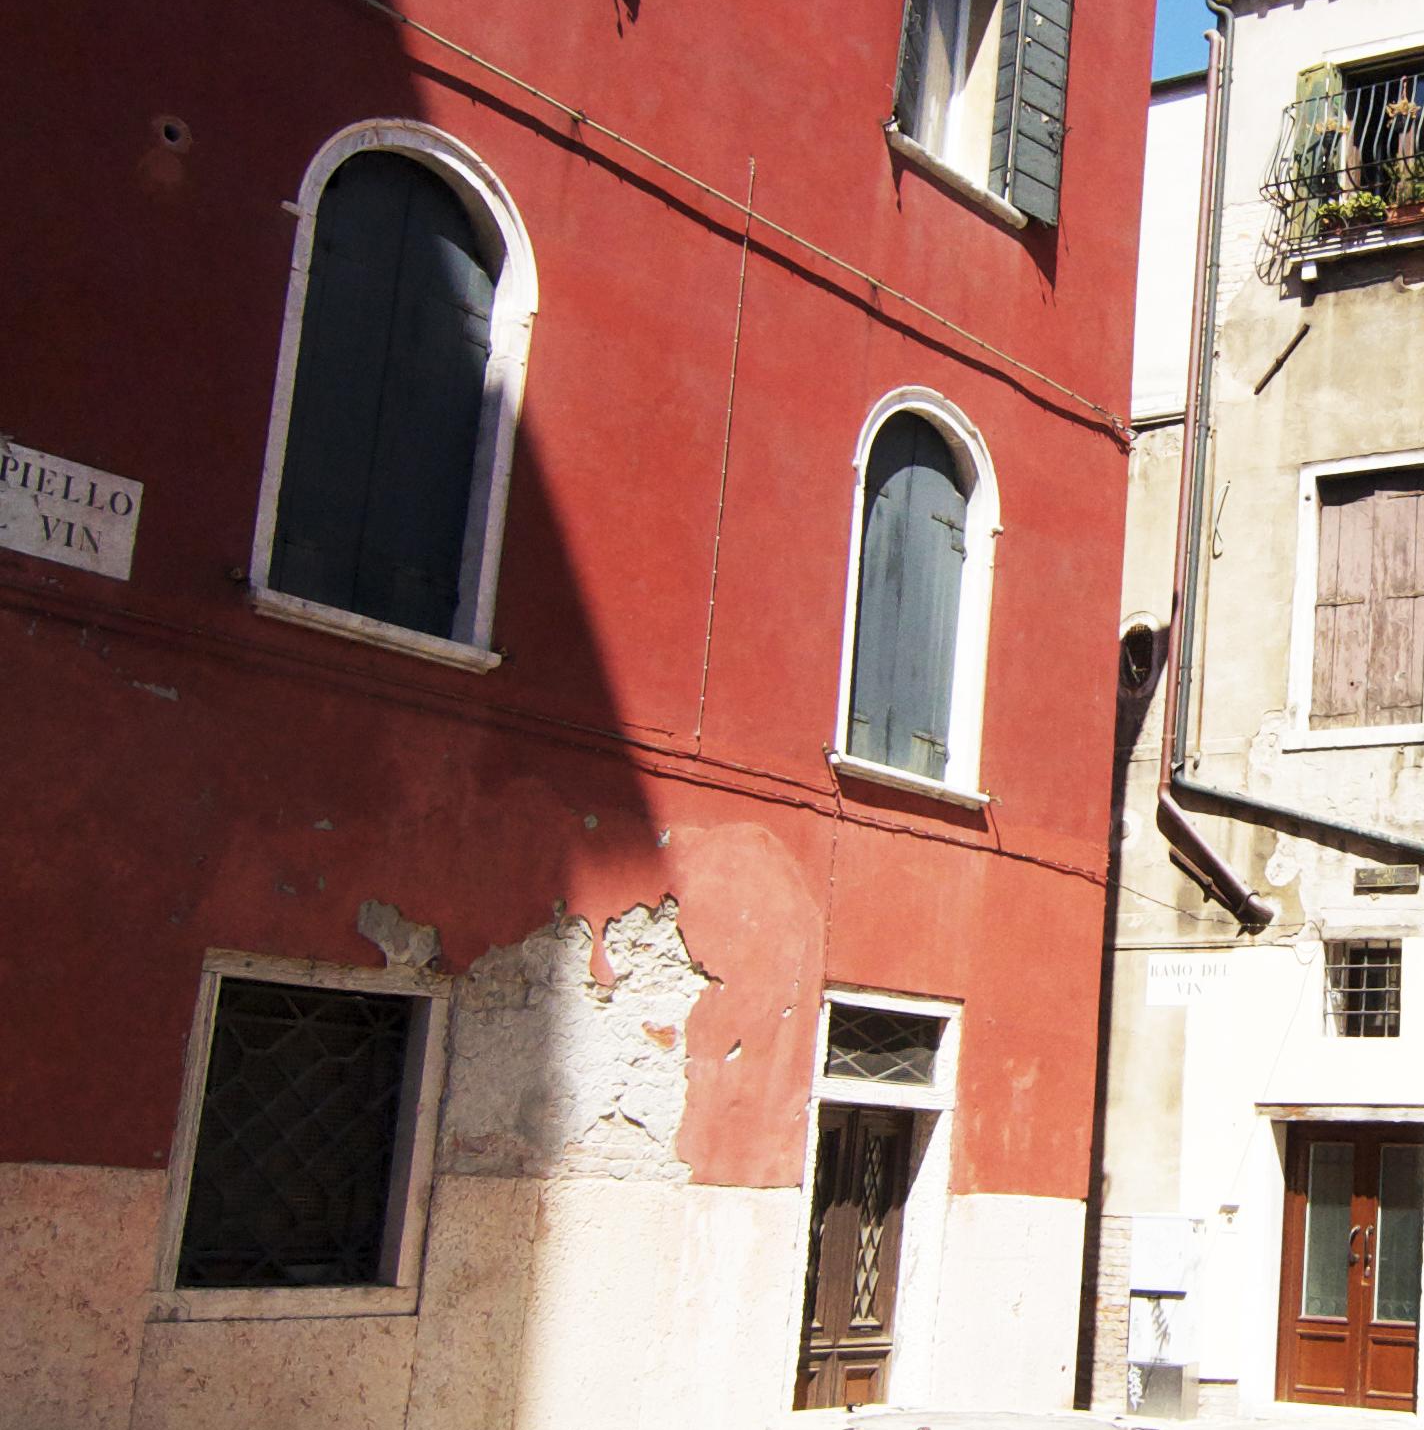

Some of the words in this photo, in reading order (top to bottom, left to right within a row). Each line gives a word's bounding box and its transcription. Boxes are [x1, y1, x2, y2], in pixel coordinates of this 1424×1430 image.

[41, 514, 102, 555] VIN
[1150, 963, 1192, 977] RAMO
[1177, 981, 1207, 995] VIN
